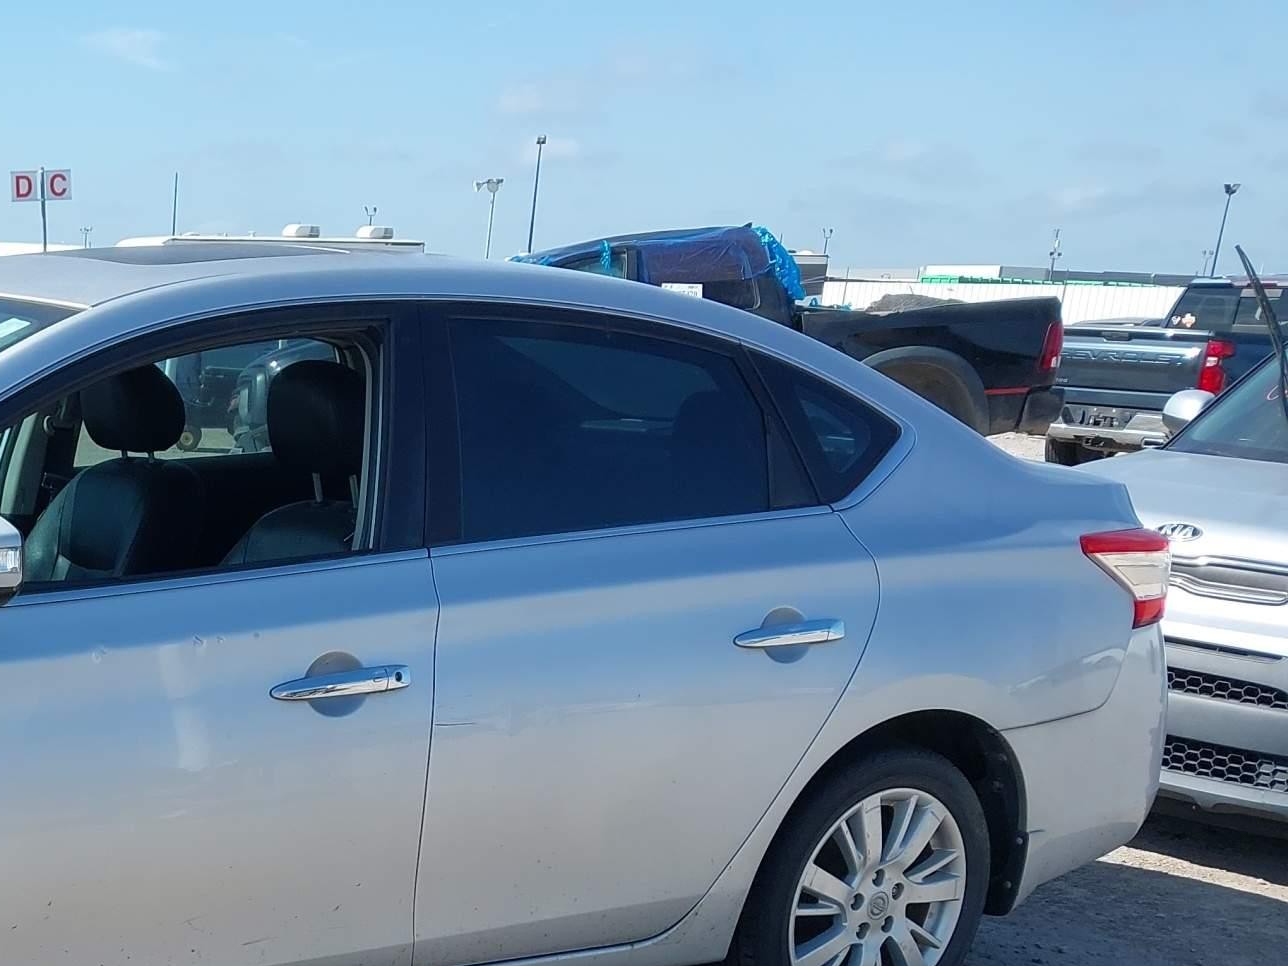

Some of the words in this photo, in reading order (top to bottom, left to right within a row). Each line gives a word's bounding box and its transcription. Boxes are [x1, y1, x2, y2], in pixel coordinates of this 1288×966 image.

[15, 175, 32, 198] D
[50, 173, 67, 197] C
[1160, 524, 1194, 537] KIA
